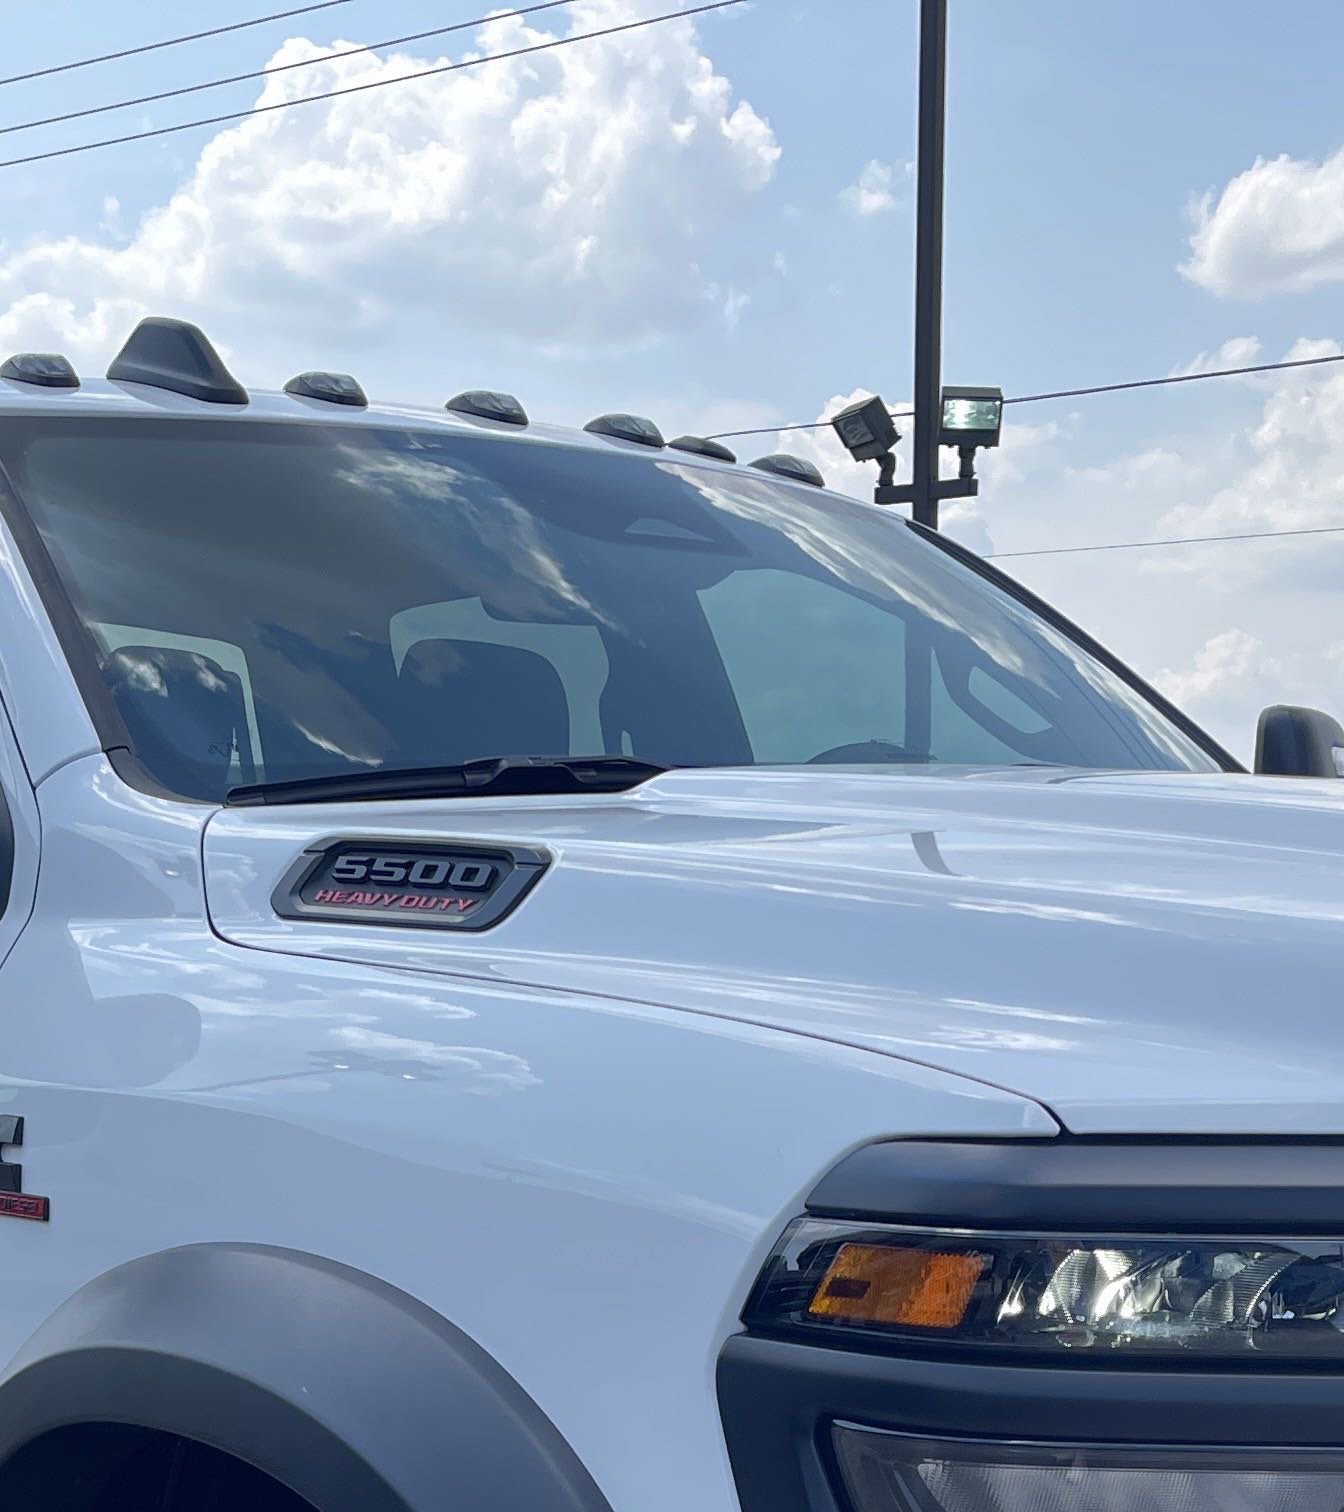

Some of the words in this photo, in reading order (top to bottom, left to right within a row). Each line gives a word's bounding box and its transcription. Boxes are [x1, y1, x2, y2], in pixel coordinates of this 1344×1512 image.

[332, 855, 496, 891] 5500
[314, 889, 399, 907] HEAVY
[400, 895, 473, 912] DUTY
